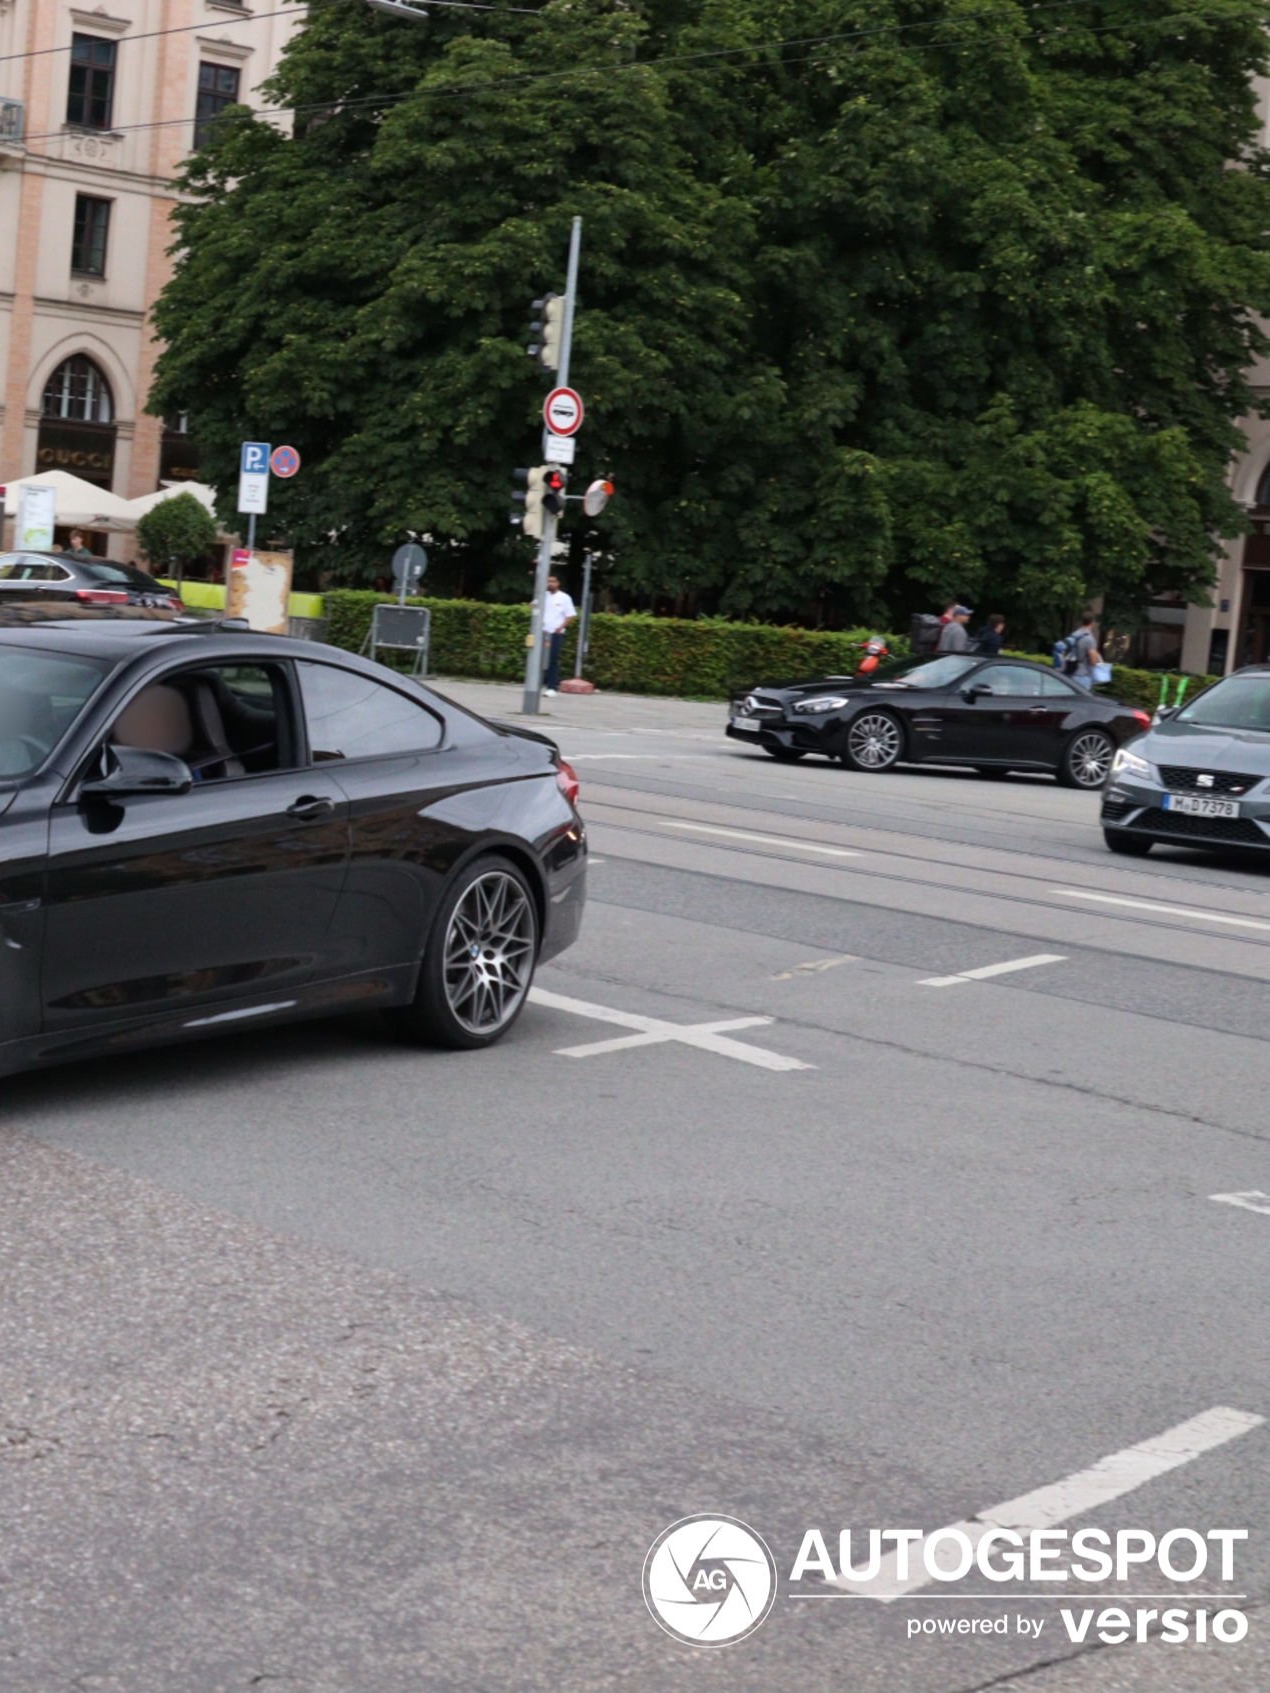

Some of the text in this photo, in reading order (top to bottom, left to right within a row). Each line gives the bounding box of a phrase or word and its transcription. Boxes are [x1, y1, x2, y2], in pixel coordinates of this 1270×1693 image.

[39, 448, 111, 468] GUCCI
[245, 446, 262, 470] P
[1175, 799, 1184, 810] M
[1202, 802, 1233, 815] 7378
